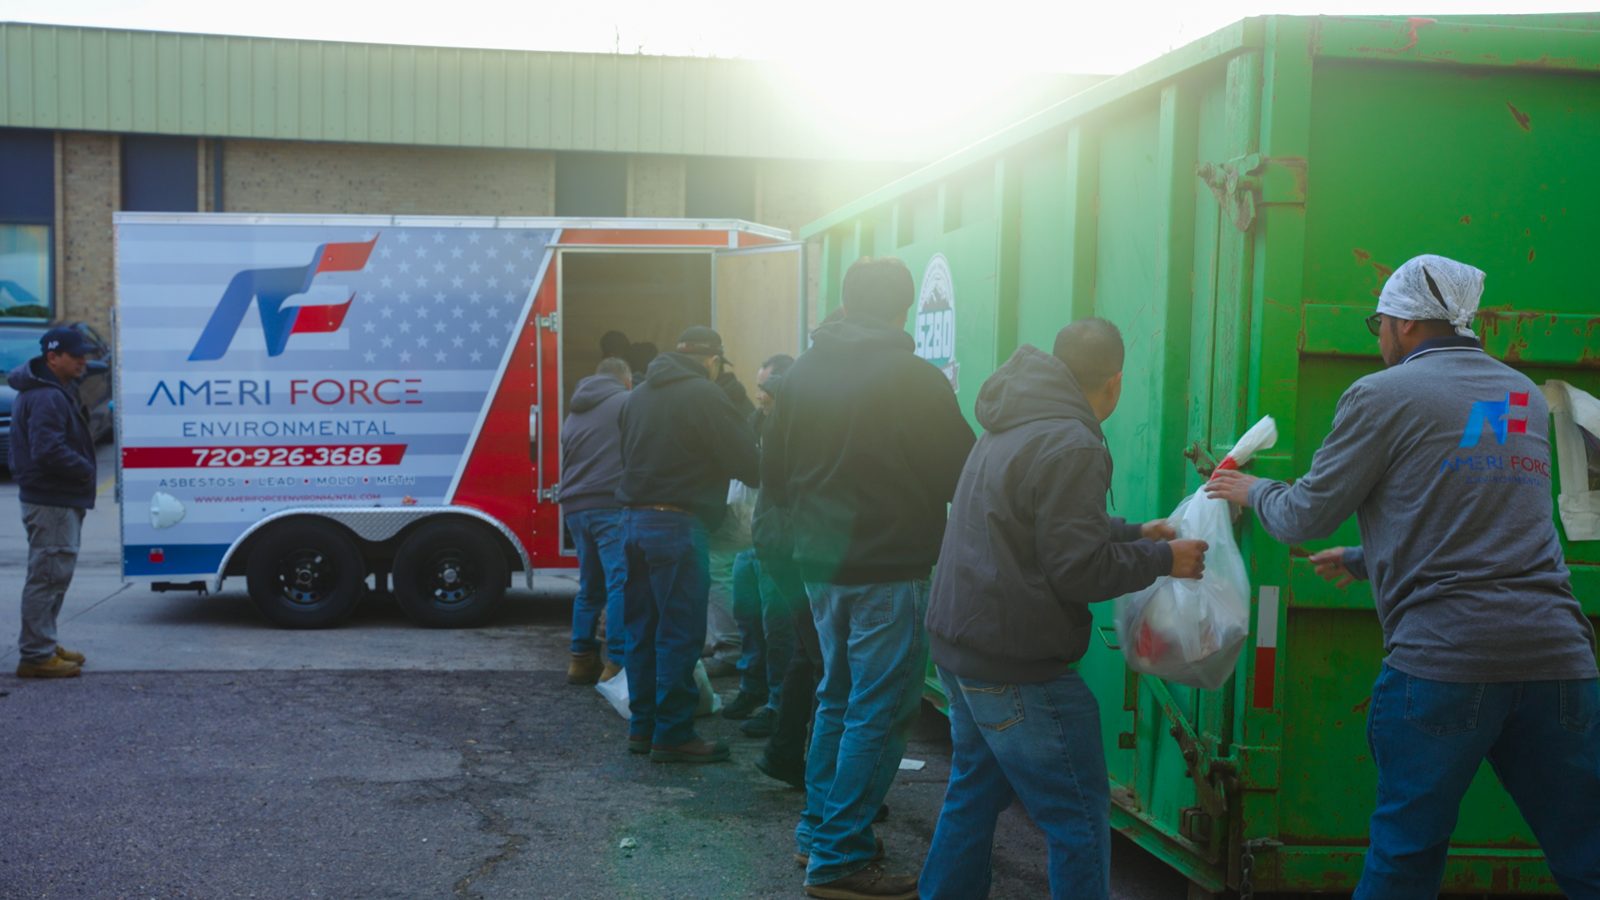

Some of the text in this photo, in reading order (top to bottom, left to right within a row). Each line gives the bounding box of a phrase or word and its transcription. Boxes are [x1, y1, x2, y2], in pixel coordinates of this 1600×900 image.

[147, 378, 423, 406] AMERI FORCE
[182, 420, 396, 437] ENVIRONMENTAL
[191, 446, 382, 467] 720-926-3686
[1439, 455, 1550, 477] AMERI FORC
[159, 474, 416, 488] ASBESTOS LEAD MOLD METH
